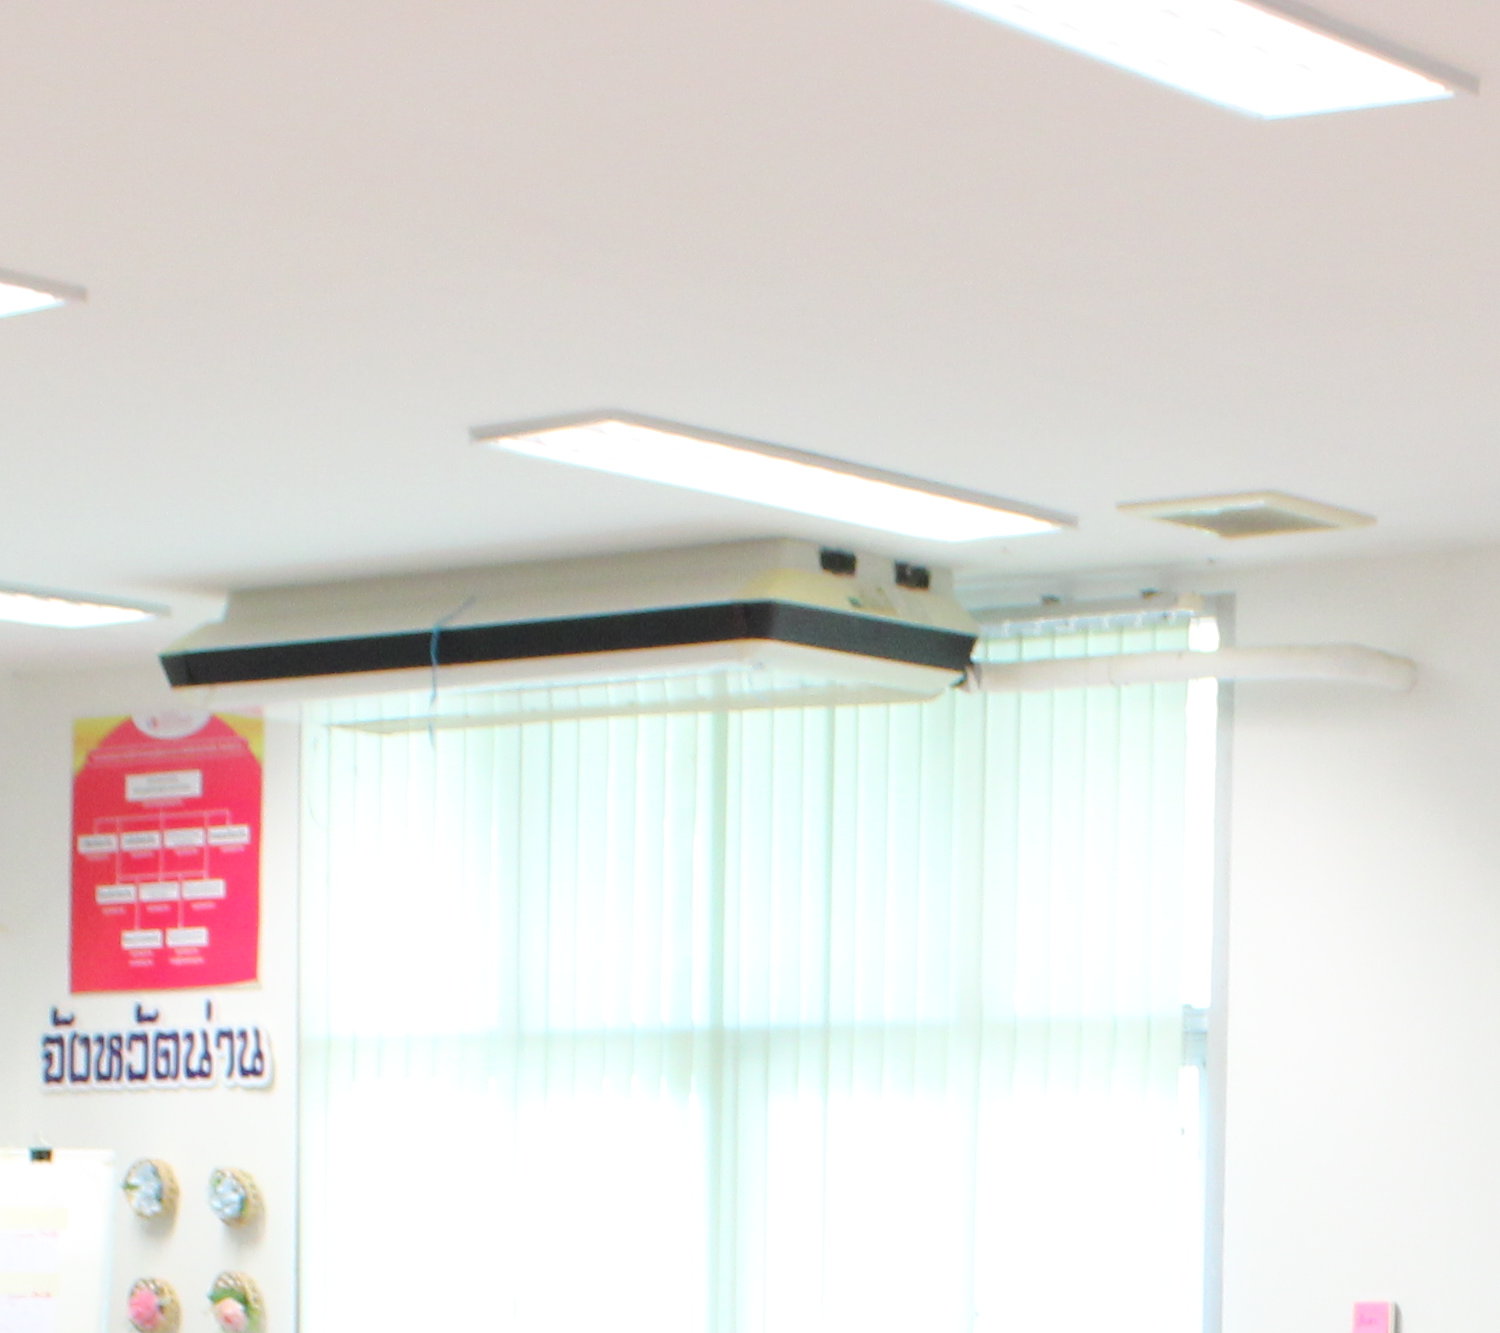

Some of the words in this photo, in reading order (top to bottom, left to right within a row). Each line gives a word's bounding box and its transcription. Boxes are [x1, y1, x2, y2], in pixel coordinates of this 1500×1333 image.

[41, 1000, 265, 1084] จังหวัดน่าน
